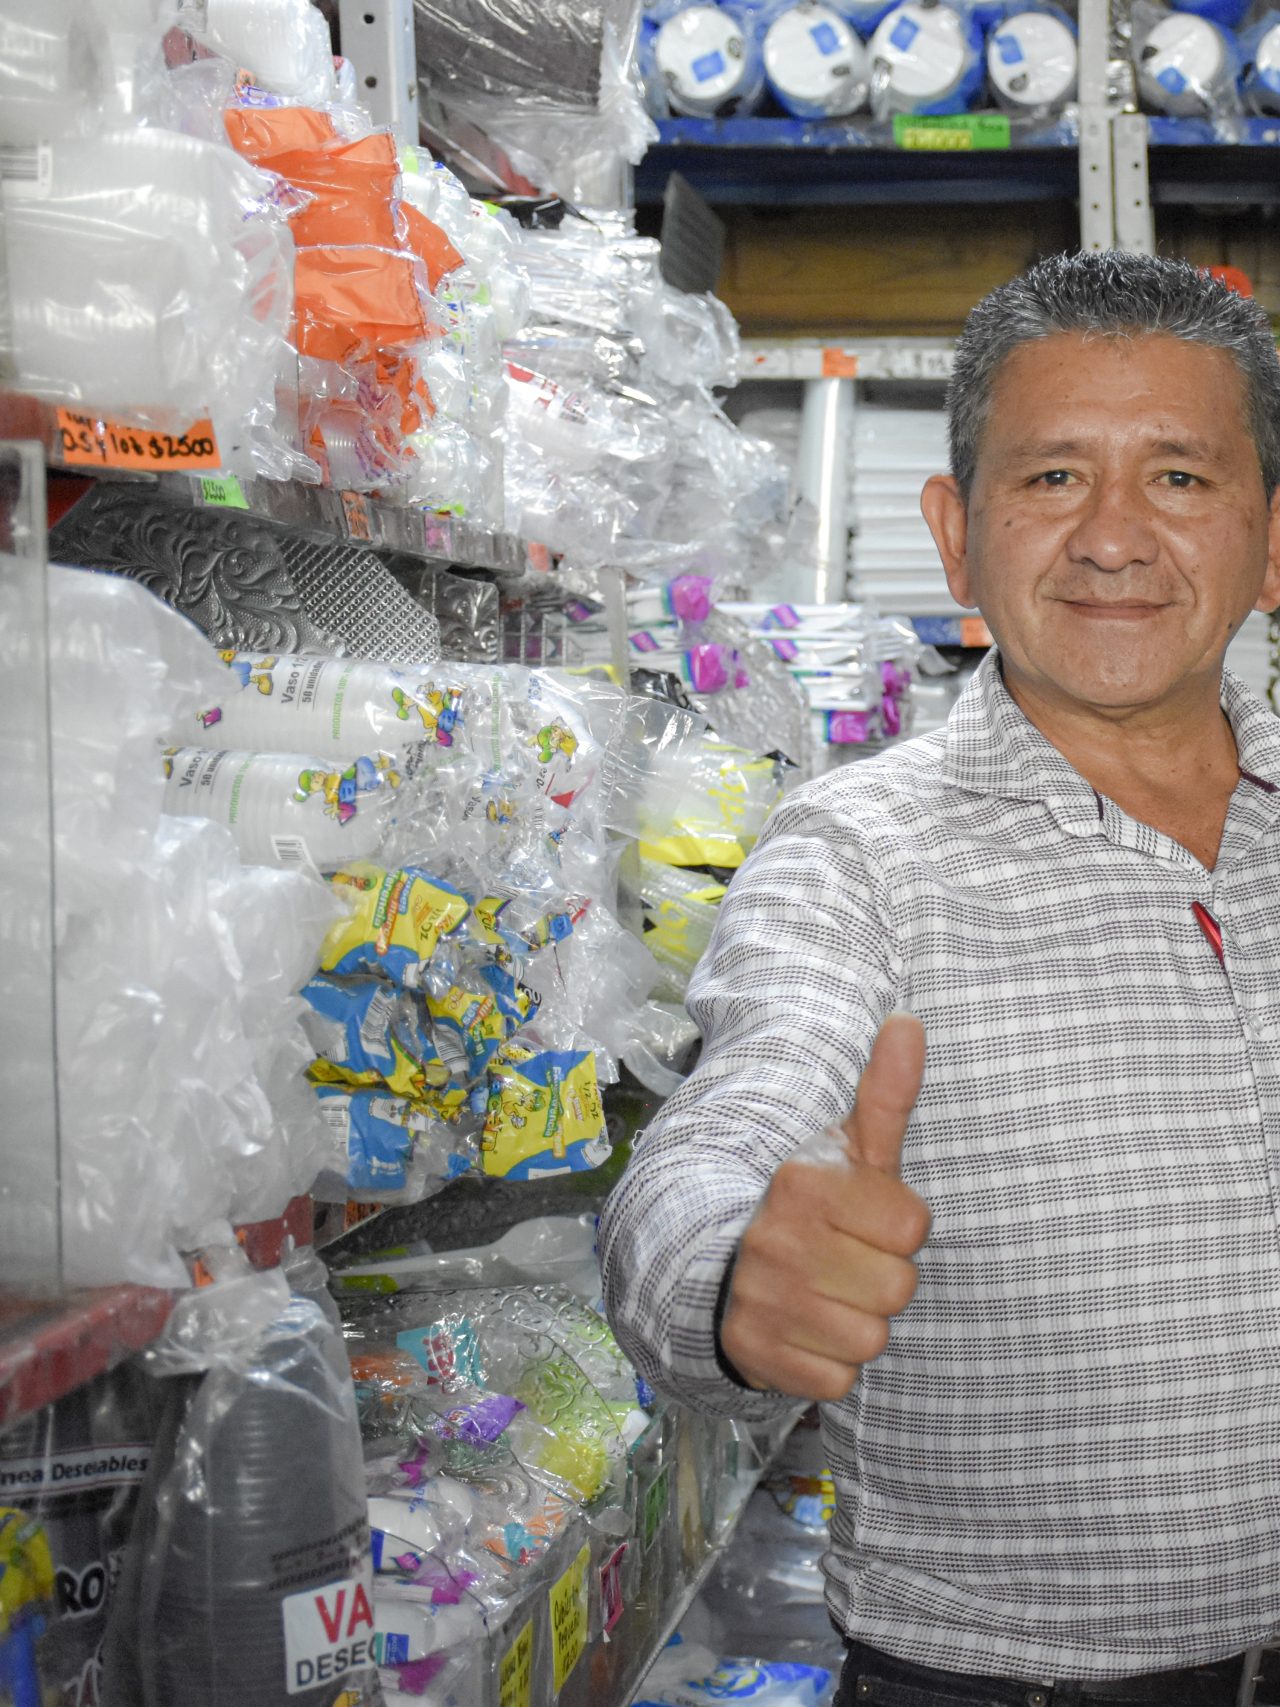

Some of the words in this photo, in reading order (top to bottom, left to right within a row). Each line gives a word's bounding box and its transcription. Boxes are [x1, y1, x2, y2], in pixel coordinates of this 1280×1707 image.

[281, 671, 300, 704] Vaso
[302, 690, 313, 703] 50
[179, 755, 203, 788] Vaso
[314, 1583, 374, 1644] VA
